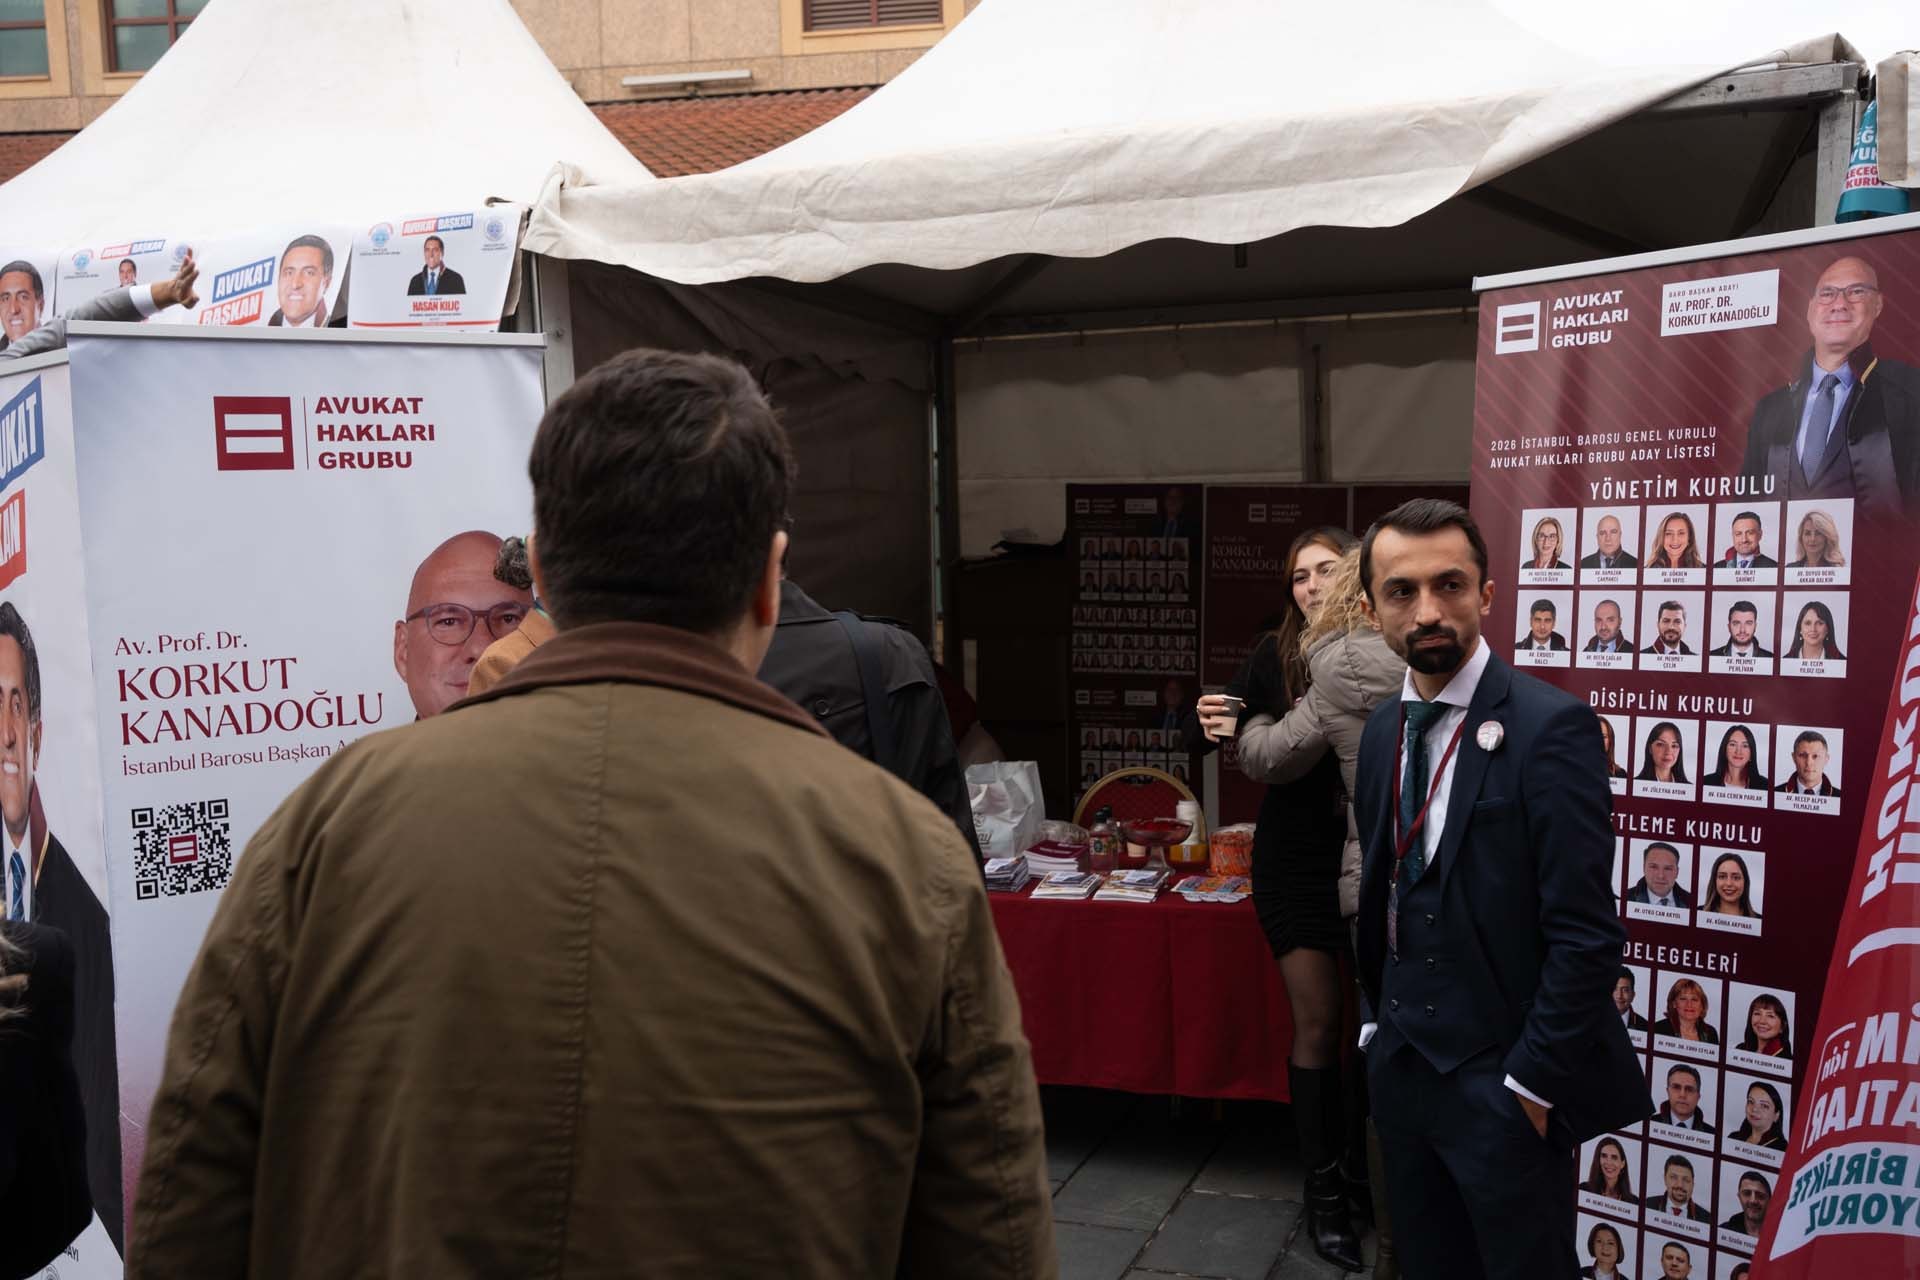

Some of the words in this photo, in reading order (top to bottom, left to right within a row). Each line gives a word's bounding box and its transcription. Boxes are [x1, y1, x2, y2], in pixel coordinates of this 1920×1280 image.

[216, 261, 273, 299] AVUKAT
[412, 302, 438, 312] HASAN
[1552, 289, 1624, 311] AVUKAT
[1668, 301, 1684, 314] AV.
[1685, 297, 1714, 312] PROF.
[1716, 295, 1734, 308] DR.
[1552, 308, 1629, 330] HAKLARI
[1668, 313, 1708, 329] KORKUT
[1709, 305, 1770, 324] KANADOĞLU
[1551, 329, 1612, 348] GRUBU
[315, 396, 424, 415] AVUKAT
[0, 392, 38, 480] UKAT
[317, 424, 435, 442] HAKLARI
[1520, 435, 1573, 449] İSTANBUL
[1577, 432, 1621, 446] BAROSU
[1625, 429, 1663, 443] GENEL
[1668, 426, 1717, 441] KURULU
[318, 451, 413, 469] GRUBU
[1490, 455, 1531, 469] AVUKAT
[1534, 452, 1584, 467] HAKLARI
[1588, 449, 1626, 464] GRUBU
[1631, 446, 1661, 461] ADAY
[1666, 445, 1716, 460] LİSTESİ
[1590, 474, 1678, 501] YÖNETİM
[1689, 474, 1776, 498] KURULU
[1211, 544, 1264, 557] KORKUT
[115, 637, 151, 656] Av.
[158, 632, 210, 653] Prof.
[216, 631, 248, 649] Dr.
[117, 657, 298, 702] KORKUT
[1590, 687, 1669, 711] DİSİPLİN
[1678, 695, 1754, 716] KURULU
[120, 689, 384, 746] KANADOĞLU
[123, 754, 196, 776] İstanbul
[201, 750, 263, 769] Barosu
[268, 743, 331, 763] Başkan
[1610, 812, 1676, 836] TLEME
[1685, 819, 1762, 845] KURULU
[1622, 941, 1739, 974] DELEGELERİ
